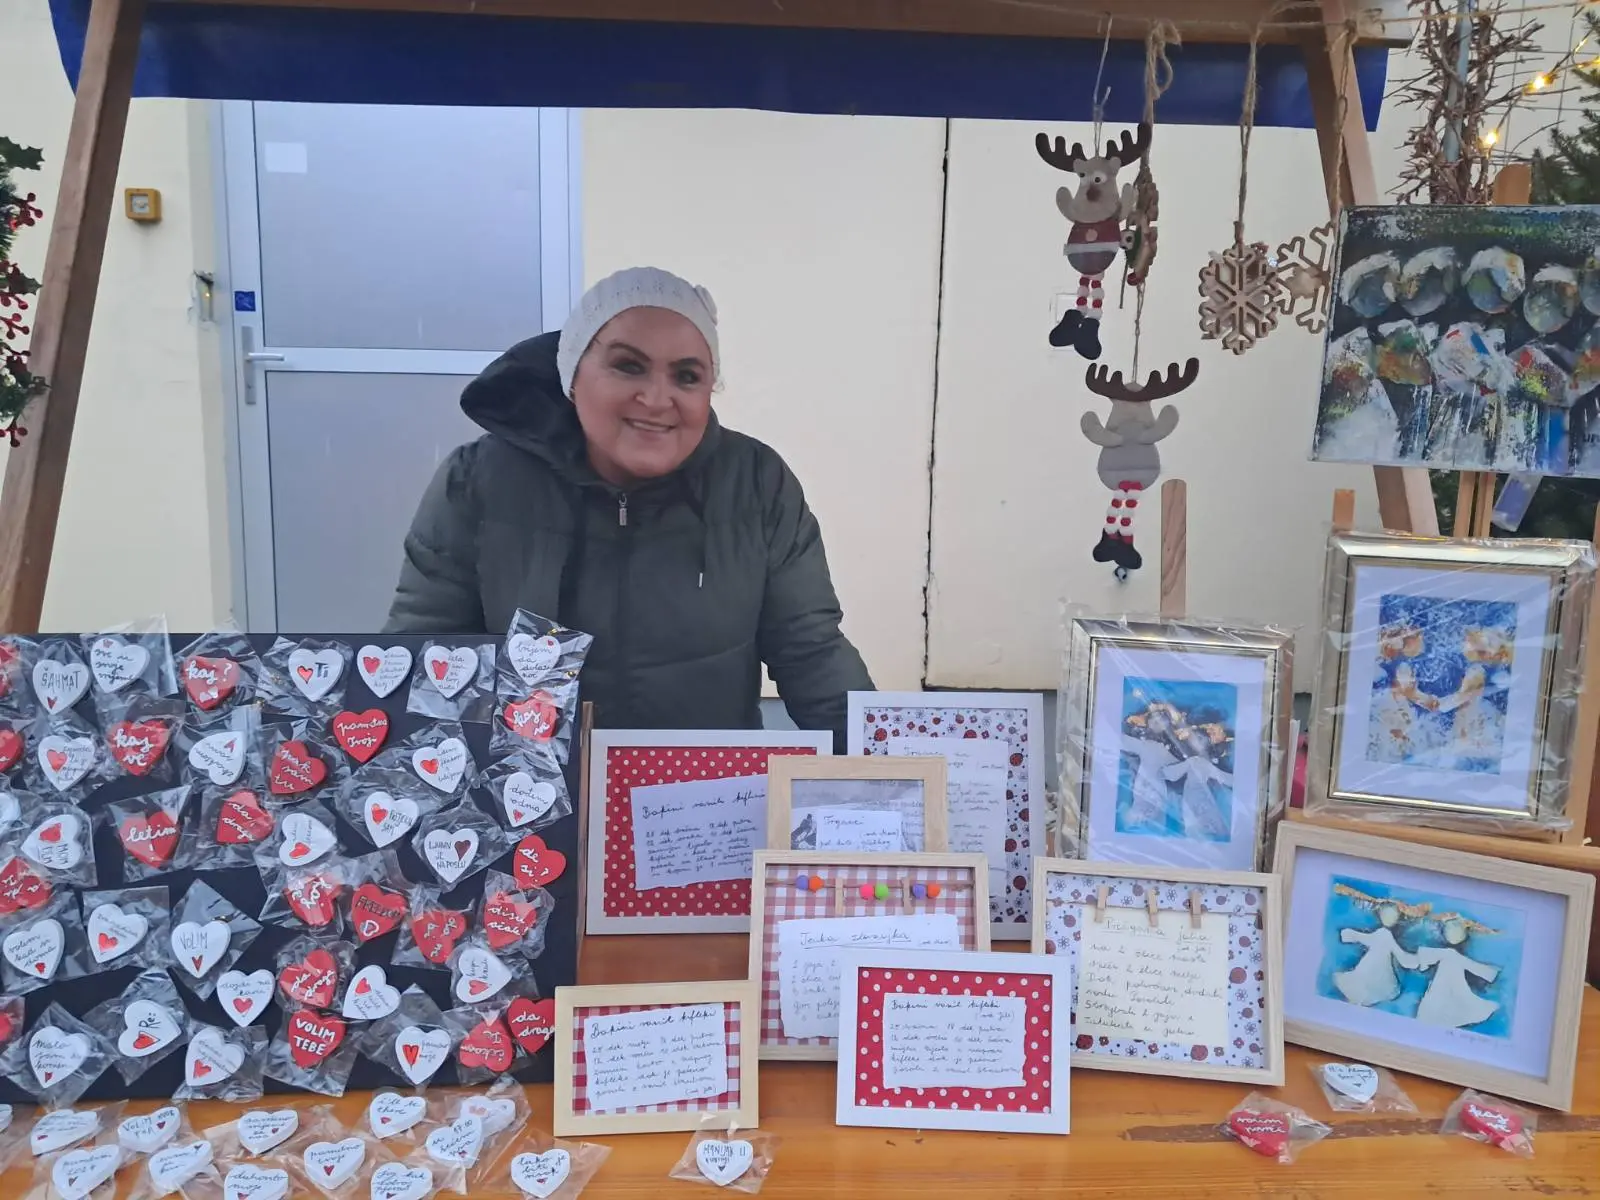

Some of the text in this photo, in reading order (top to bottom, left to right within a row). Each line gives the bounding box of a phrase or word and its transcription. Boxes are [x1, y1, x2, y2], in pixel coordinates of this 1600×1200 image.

[314, 661, 329, 679] Ti
[41, 667, 81, 694] ŠAHMAT
[126, 826, 178, 843] letim
[179, 932, 209, 951] VOLIM
[296, 1018, 337, 1043] VOLIM
[294, 1035, 328, 1056] TEBE
